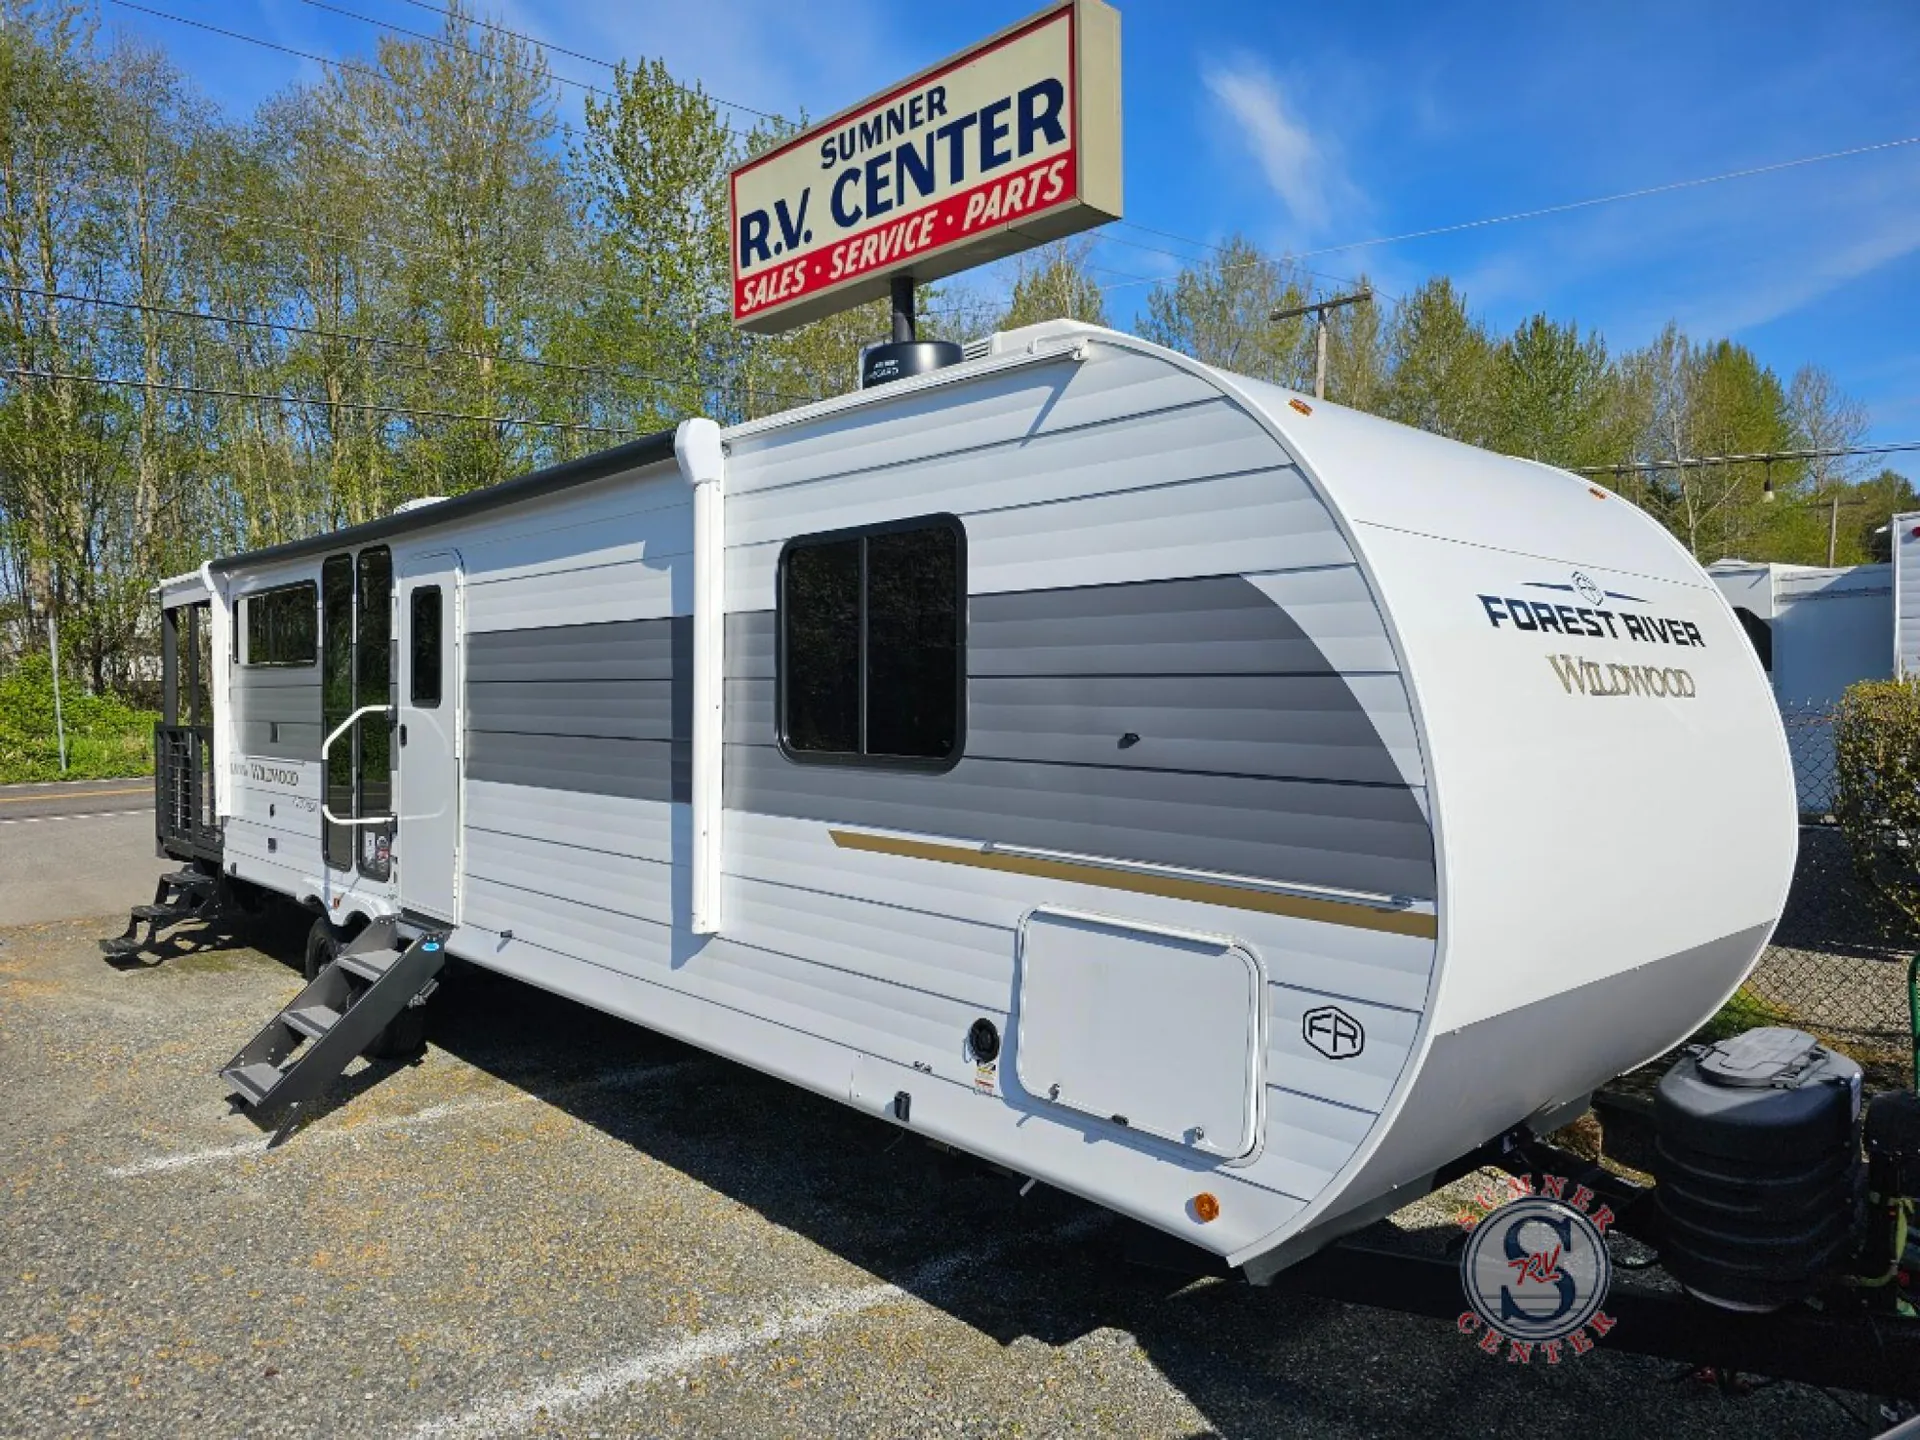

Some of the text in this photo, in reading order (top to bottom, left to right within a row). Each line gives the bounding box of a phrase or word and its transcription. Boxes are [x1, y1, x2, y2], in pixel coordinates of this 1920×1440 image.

[740, 78, 1066, 269] R.V. CENTER
[821, 86, 947, 170] SUMNER
[741, 159, 1067, 312] SALES SERVICE PARTS
[1476, 594, 1706, 647] FOREST RIVER
